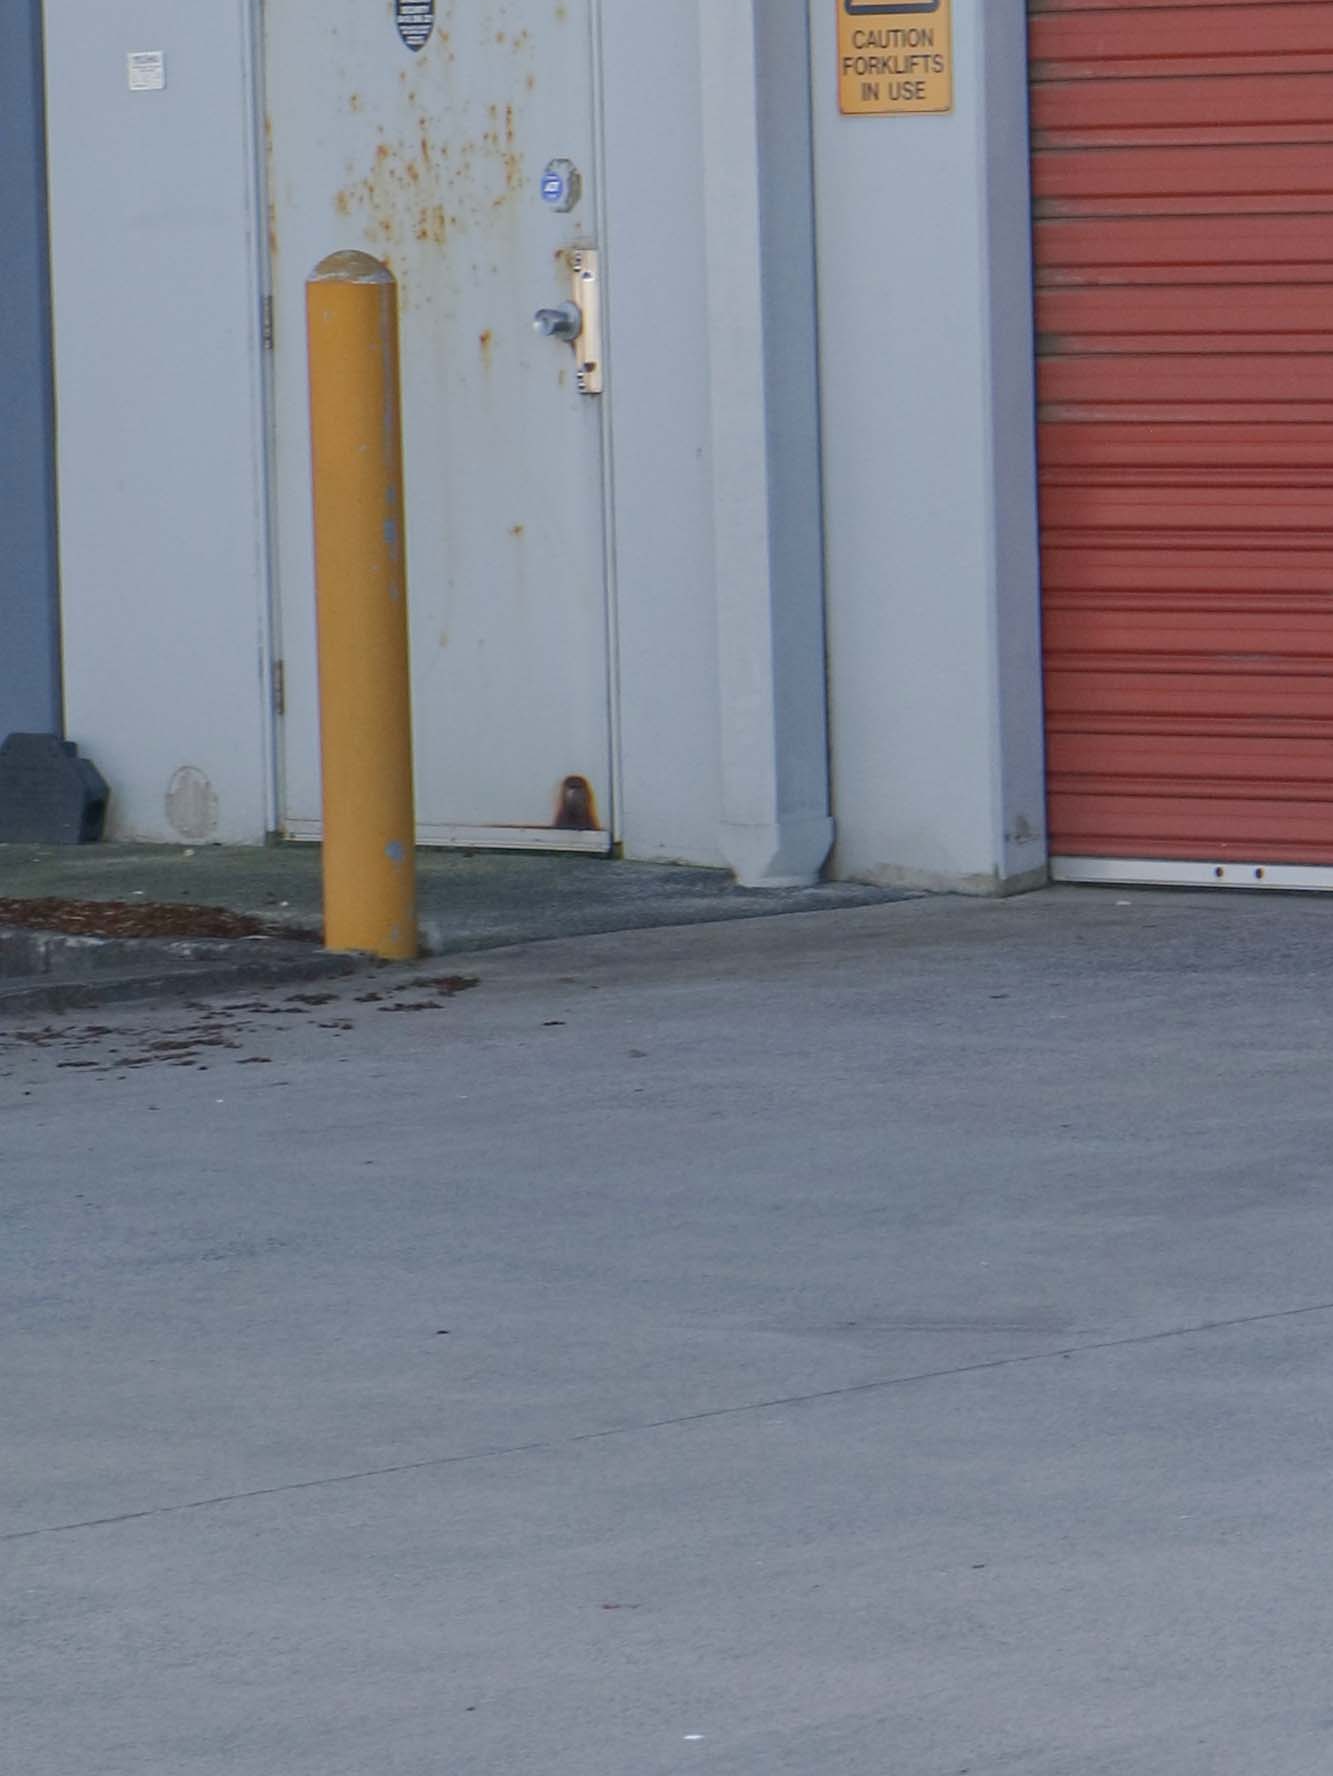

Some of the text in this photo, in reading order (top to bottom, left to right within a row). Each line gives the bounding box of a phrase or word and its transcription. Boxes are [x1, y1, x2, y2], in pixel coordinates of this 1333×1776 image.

[852, 28, 935, 50] CAUTION
[842, 54, 946, 77] FORKLIFTS
[861, 80, 927, 102] IN USE
